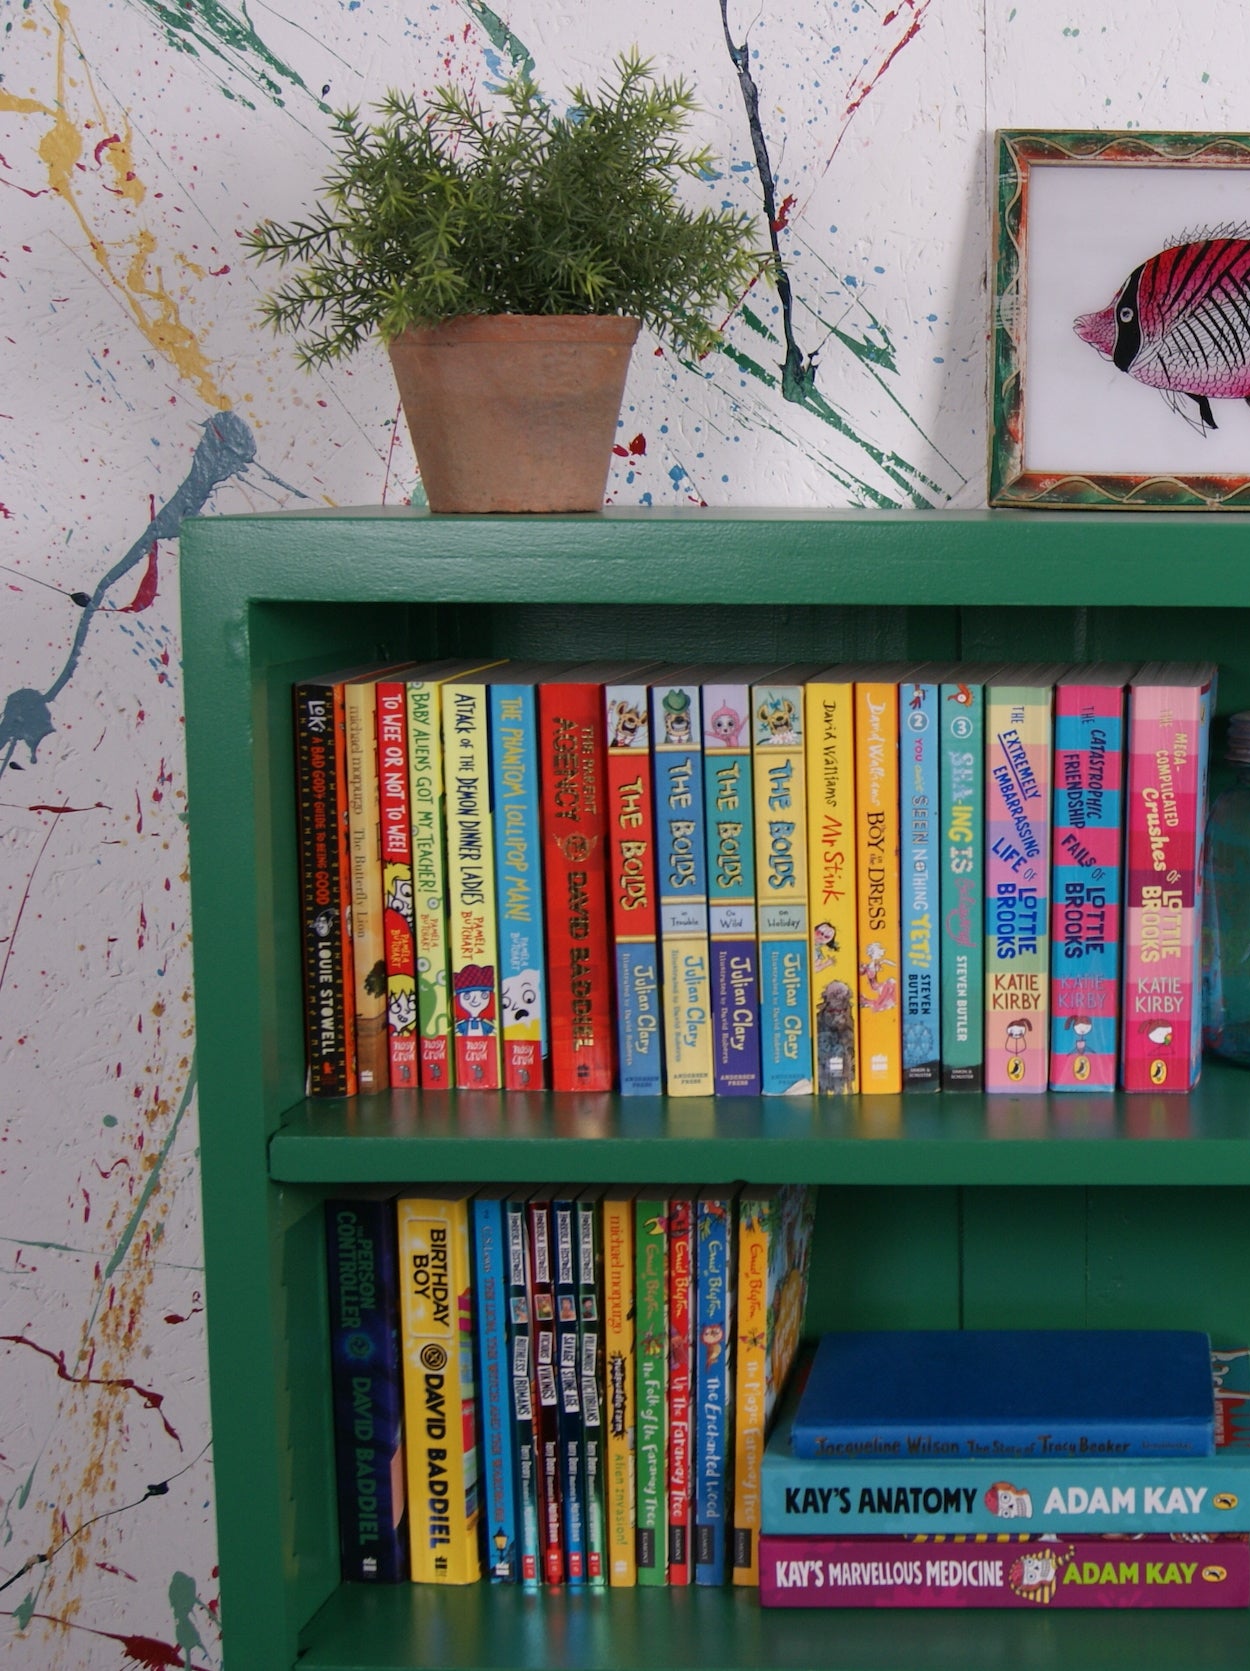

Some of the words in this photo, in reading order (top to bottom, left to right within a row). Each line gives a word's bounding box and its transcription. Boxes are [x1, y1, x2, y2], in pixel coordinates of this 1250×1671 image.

[382, 714, 403, 742] WEE
[411, 692, 430, 725] BABY
[454, 693, 476, 734] ATTACK
[500, 696, 523, 721] THE
[823, 700, 837, 741] David
[866, 692, 886, 741] David
[913, 716, 923, 728] 2
[956, 720, 967, 735] 3
[1011, 706, 1024, 724] THE
[1081, 705, 1095, 725] THE
[1159, 708, 1173, 727] THE
[350, 706, 361, 753] michael
[413, 728, 432, 772] ALIENS
[581, 724, 595, 754] THE
[914, 738, 923, 762] YOU
[311, 747, 326, 768] BAD
[384, 747, 403, 767] OR
[458, 754, 475, 772] THE
[500, 727, 527, 798] PHANTOM
[552, 716, 581, 823] AGENCY
[824, 745, 838, 808] Walliams
[1002, 729, 1042, 799] EXTREMELY
[1086, 729, 1106, 820] CATASTROPHIC
[352, 757, 363, 815] morpurgo
[415, 776, 433, 804] GOT
[455, 777, 479, 816] DEMON
[582, 759, 596, 815] PARENT
[618, 776, 643, 830] THE
[667, 757, 692, 811] THE
[715, 760, 740, 812] THE
[768, 759, 794, 812] THE
[1063, 753, 1085, 829] FRIENDSHIP
[1155, 750, 1179, 828] COMPLICATED
[314, 801, 327, 829] GUIDE
[418, 811, 433, 829] MY
[821, 814, 843, 847] Mr
[912, 795, 929, 845] SEEN
[992, 765, 1040, 859] EMBARRASSING
[1141, 787, 1170, 872] Crushes
[315, 843, 328, 869] BEING
[353, 828, 365, 851] The
[386, 824, 408, 854] WEE!
[458, 821, 483, 861] DINNER
[504, 804, 529, 872] LOLLIPOP
[668, 819, 696, 889] BOLDS
[716, 821, 743, 890] BOLDS
[768, 821, 796, 890] BOLDS
[991, 837, 1028, 873] LIFE
[1061, 833, 1097, 868] FAILS
[416, 832, 438, 893] TEACHER!
[619, 840, 648, 911] BOLDS
[822, 851, 845, 905] Stink
[912, 849, 929, 911] NOTHING
[950, 846, 973, 874] IS
[315, 871, 330, 905] GOOD
[354, 856, 368, 906] Butterfly
[460, 867, 485, 906] LADIES
[504, 875, 532, 922] MAN!
[868, 867, 886, 931] DRESS
[356, 911, 368, 938] Lion
[567, 870, 590, 940] DAVID
[670, 917, 699, 927] Trouble
[719, 918, 744, 928] Wild
[767, 917, 801, 930] Holiday
[996, 883, 1016, 959] BROOKS
[1018, 887, 1037, 955] LOTTIE
[1064, 883, 1084, 959] BROOKS
[1085, 887, 1105, 955] LOTTIE
[1141, 885, 1162, 963] BROOKS
[1162, 890, 1182, 959] LOTTIE
[390, 929, 401, 967] BUTCHART
[400, 934, 410, 964] PAMELA
[420, 914, 429, 952] BUTCHART
[430, 918, 439, 949] PAMELA
[461, 911, 473, 961] BUTCHART
[473, 916, 484, 955] PAMELA
[510, 932, 520, 970] BUTCHART
[520, 937, 529, 966] PAMELA
[317, 941, 332, 983] LOUIE
[684, 956, 706, 1003] Julian
[730, 957, 754, 1006] Julian
[783, 953, 801, 1007] Julian
[956, 955, 968, 998] STEVEN
[994, 974, 1039, 991] KATIE
[1060, 975, 1104, 990] KATIE
[569, 947, 594, 1052] BADDIEL
[634, 965, 656, 1011] Julian
[908, 974, 919, 1016] BUTLER
[920, 974, 931, 1015] STEVEN
[992, 993, 1041, 1010] KIRBY
[1057, 992, 1106, 1009] KIRBY
[1135, 996, 1184, 1013] KIRBY
[1138, 977, 1182, 994] KATIE
[320, 989, 335, 1055] STOWELL
[635, 1015, 657, 1054] Clary
[683, 1006, 706, 1048] Clary
[730, 1009, 754, 1051] Clary
[784, 1015, 803, 1060] Clary
[956, 1000, 968, 1042] BUTLER
[610, 1216, 624, 1268] michael
[337, 1211, 362, 1329] CONTROLLER
[357, 1239, 376, 1309] PERSON
[413, 1254, 431, 1299] BOY
[430, 1228, 449, 1327] BIRTHDAY
[608, 1270, 624, 1335] morpurgo
[645, 1279, 660, 1319] Blyton
[673, 1277, 689, 1318] Blyton
[706, 1277, 723, 1319] Blyton
[747, 1279, 763, 1319] Blyton
[515, 1337, 527, 1372] RUTHLESS
[563, 1336, 575, 1362] SAVAGE
[583, 1336, 595, 1372] VILLAINOUS
[515, 1379, 530, 1416] ROMANS
[540, 1368, 554, 1400] VIKINGS
[562, 1371, 575, 1391] STONE
[565, 1394, 577, 1408] AGE
[583, 1378, 598, 1422] VICTORIANS
[646, 1380, 660, 1407] Folk
[706, 1377, 720, 1402] The
[352, 1377, 374, 1441] DAVID
[424, 1374, 446, 1440] DAVID
[641, 1408, 658, 1422] of
[743, 1381, 760, 1424] Magic
[671, 1421, 689, 1484] Faraway
[704, 1403, 721, 1477] Enchanted
[742, 1427, 760, 1489] Faraway
[815, 1436, 900, 1457] Jacqueline
[906, 1434, 960, 1454] Wilson
[967, 1440, 989, 1453] The
[992, 1440, 1023, 1456] Story
[1024, 1442, 1036, 1454] of
[1037, 1434, 1076, 1457] Tracy
[1079, 1437, 1131, 1453] Beaker
[615, 1453, 625, 1485] Alien
[641, 1444, 660, 1494] Faraway
[354, 1449, 379, 1545] BADDIEL
[427, 1448, 450, 1549] BADDIEL
[645, 1498, 659, 1526] Tree
[671, 1489, 687, 1517] Tree
[743, 1494, 760, 1523] Tree
[785, 1487, 852, 1514] KAY'S
[858, 1487, 978, 1514] ANATOMY
[1043, 1487, 1135, 1515] ADAM
[1144, 1487, 1208, 1515] KAY
[776, 1560, 824, 1588] KAY'S
[829, 1561, 922, 1586] MARVELLOUS
[926, 1561, 1004, 1587] MEDICINE
[1063, 1562, 1139, 1584] ADAM
[1146, 1562, 1198, 1584] KAY
